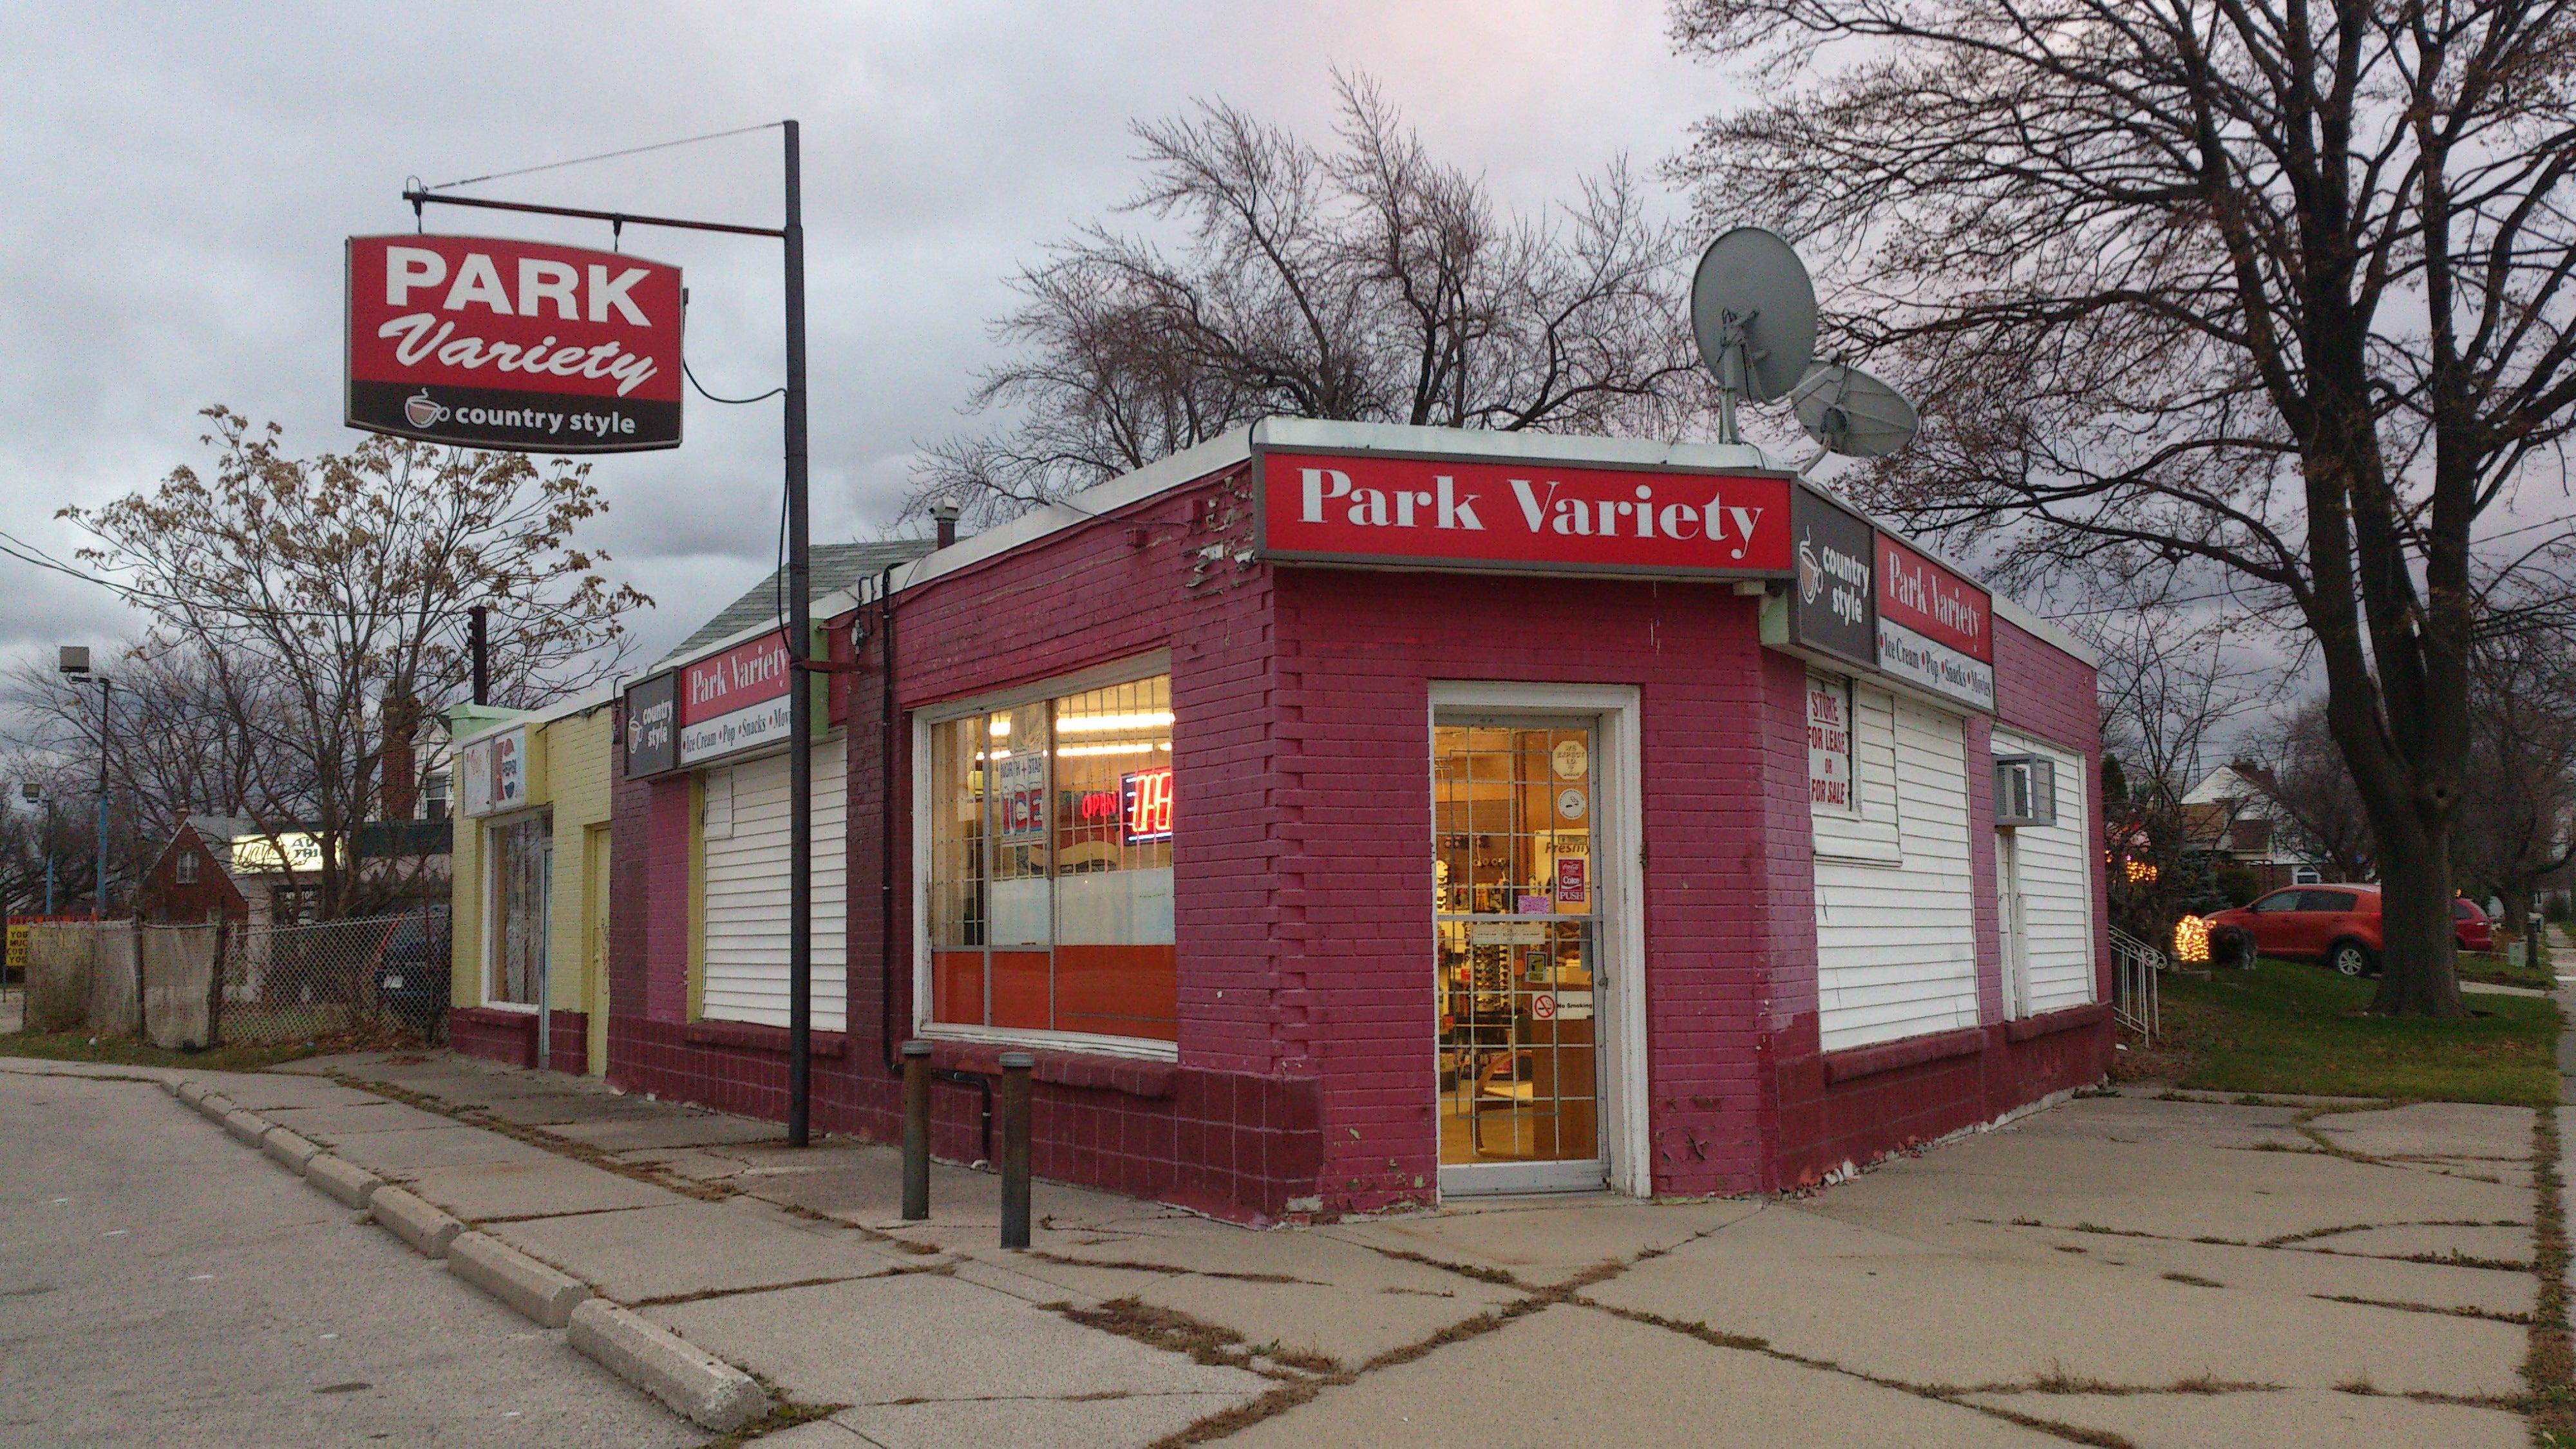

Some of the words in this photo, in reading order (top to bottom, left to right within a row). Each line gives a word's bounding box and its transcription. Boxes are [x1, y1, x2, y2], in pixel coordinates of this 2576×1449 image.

[386, 245, 652, 327] PARK
[378, 312, 658, 398] Variety
[456, 404, 564, 435] country
[569, 410, 637, 438] style
[1296, 467, 1486, 531] Park
[1508, 478, 1764, 560] Variety
[1823, 545, 1870, 598] country
[1832, 585, 1862, 627] style
[1888, 550, 1928, 615] Park
[1931, 573, 1980, 653] Variety
[691, 661, 727, 705] Park
[730, 644, 787, 688] Variety
[1884, 632, 1895, 660] Ice
[1897, 638, 1919, 670] Cream
[1926, 652, 1938, 684] Pop
[1945, 659, 1967, 688] Snacks
[1971, 669, 1991, 699] Movies
[643, 699, 673, 726] country
[1811, 691, 1839, 722] STORE
[648, 723, 668, 751] style
[687, 735, 696, 753] Ice
[697, 730, 717, 750] Cream
[723, 724, 735, 746] Pop
[742, 714, 766, 737] Snacks
[1807, 726, 1823, 750] FOR
[1825, 730, 1846, 754] LEASE
[1825, 757, 1832, 774] OR
[1082, 791, 1117, 819] OPEN
[1812, 779, 1826, 803] FOR
[1828, 779, 1845, 804] SALE
[1002, 788, 1042, 835] ICE
[1560, 891, 1584, 900] PUSH
